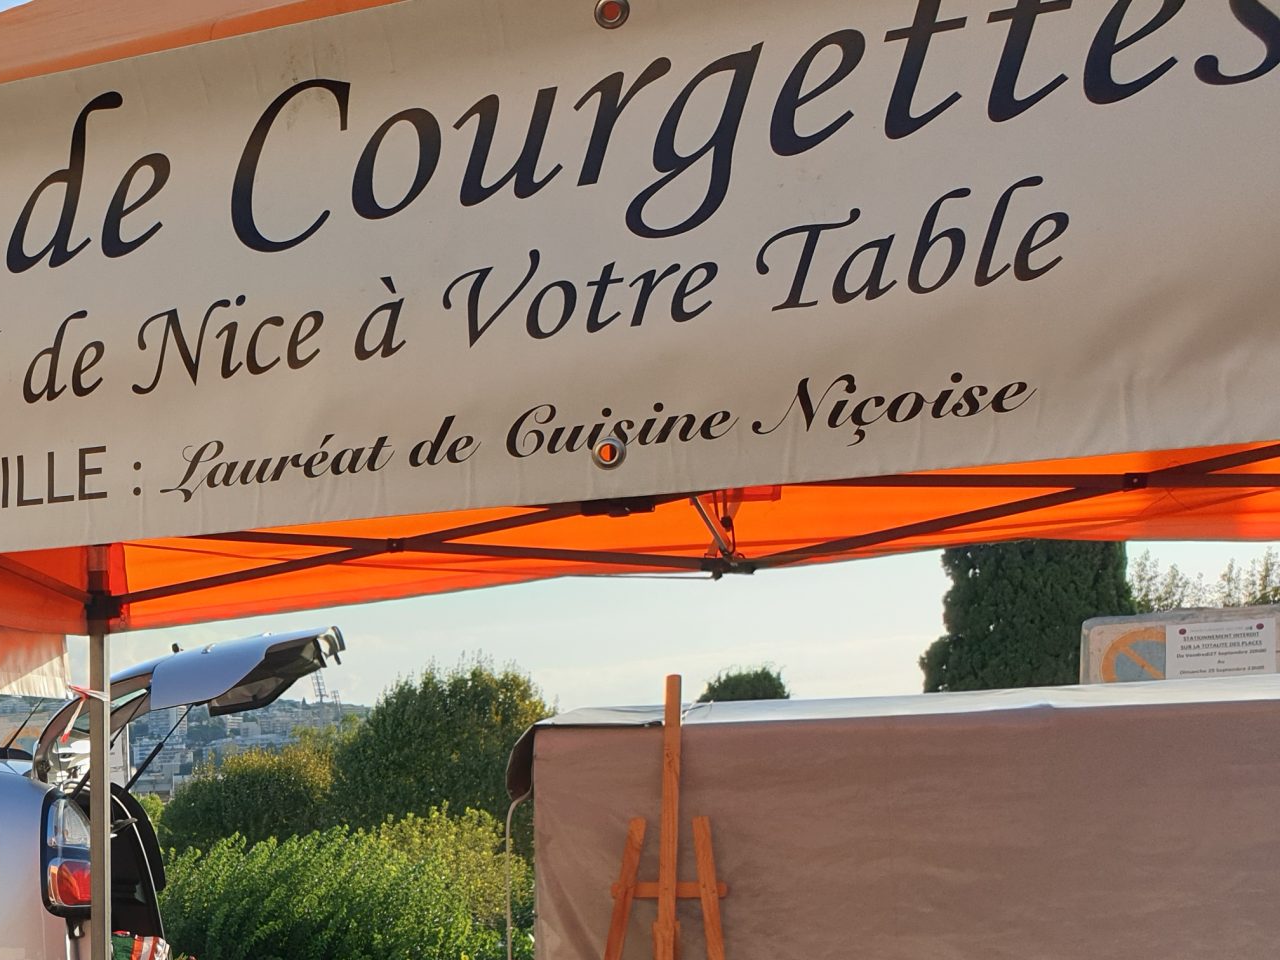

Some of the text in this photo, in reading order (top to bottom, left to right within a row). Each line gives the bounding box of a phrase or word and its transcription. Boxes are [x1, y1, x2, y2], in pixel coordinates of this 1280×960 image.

[7, 91, 170, 273] de
[231, 0, 1280, 252] Courgettes
[23, 310, 104, 404] de
[132, 295, 324, 394] Nice
[355, 276, 406, 361] à
[443, 249, 718, 348] Votre
[756, 176, 1069, 311] Table
[160, 439, 395, 502] Lauréat
[409, 415, 481, 468] de
[506, 403, 739, 458] Cuisine
[752, 372, 1037, 447] Niçoise
[1233, 631, 1260, 639] INTERDIT
